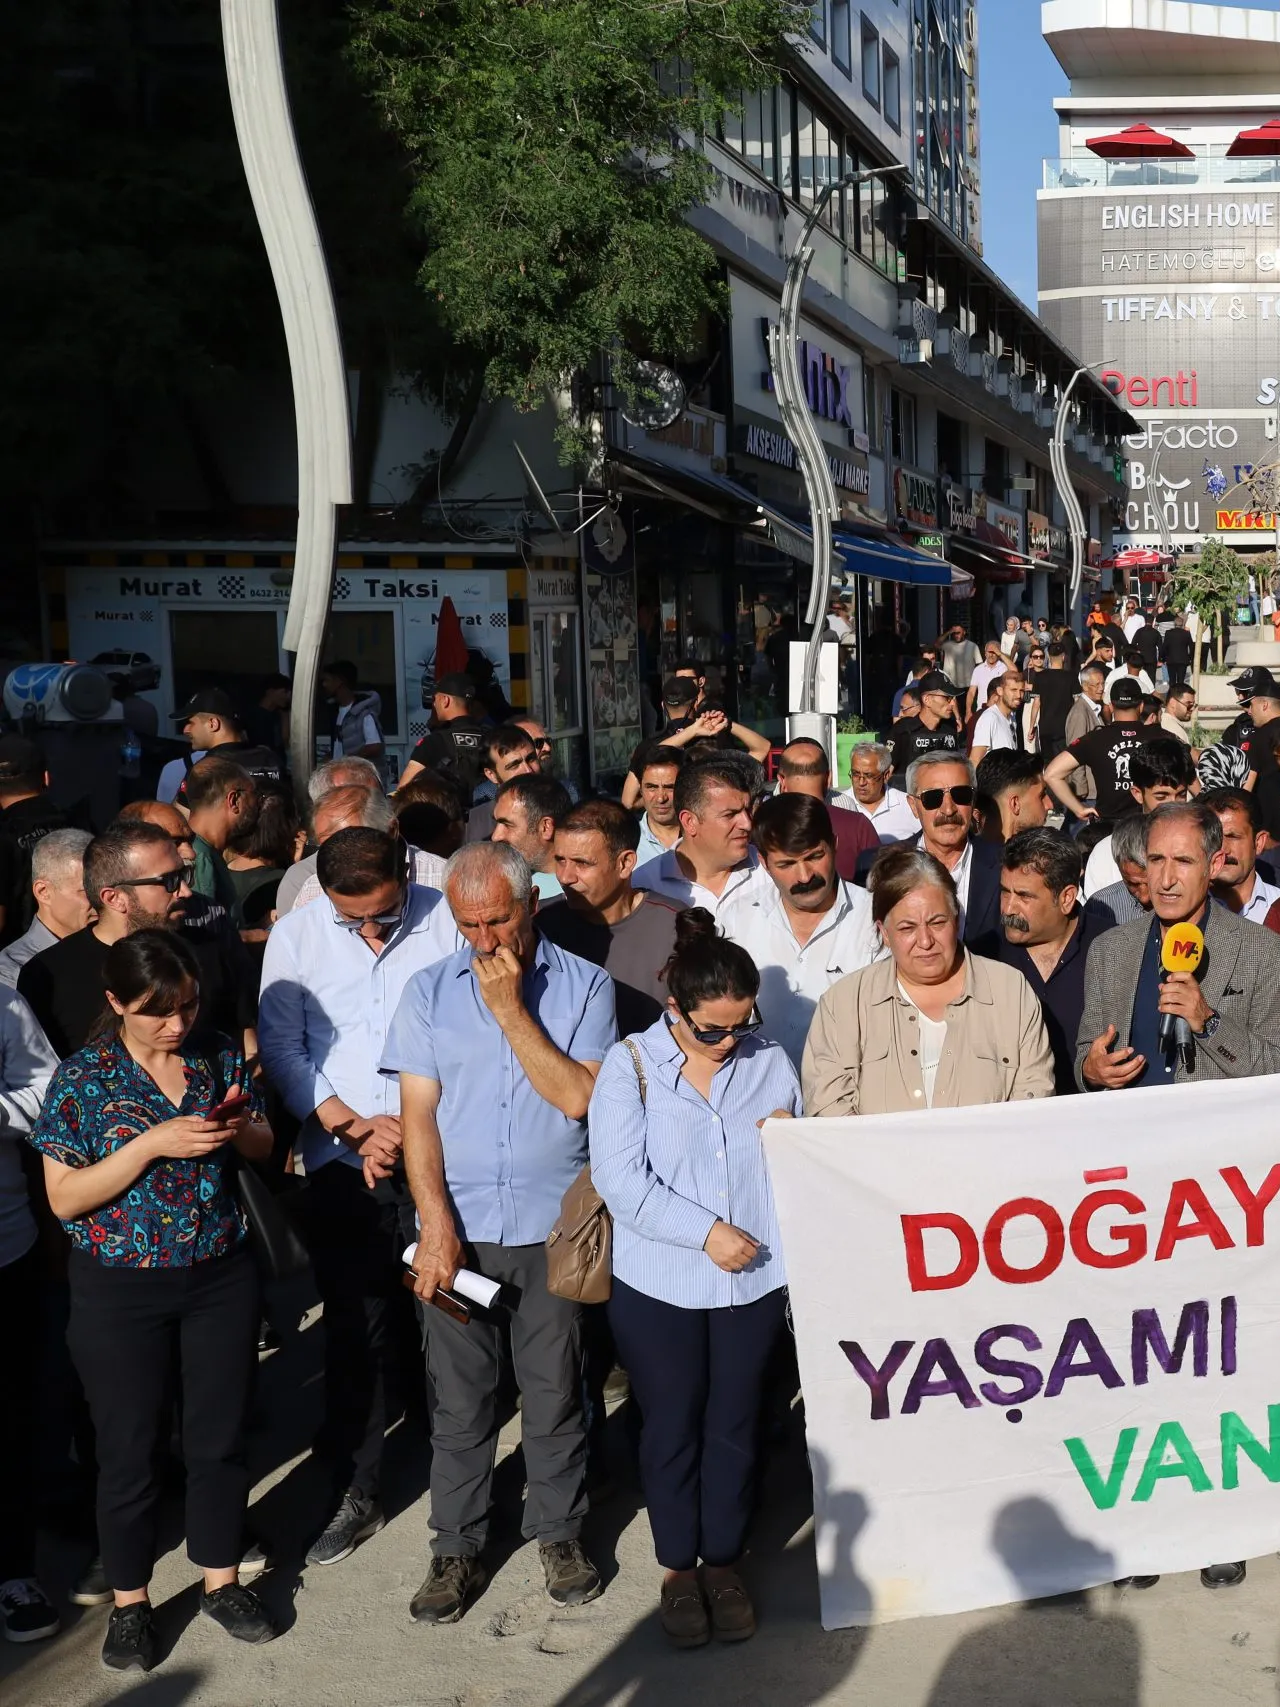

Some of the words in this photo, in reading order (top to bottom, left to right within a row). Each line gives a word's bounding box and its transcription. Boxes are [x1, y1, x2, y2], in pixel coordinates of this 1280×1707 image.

[1102, 204, 1199, 230] ENGLISH
[1207, 202, 1274, 228] HOME
[1102, 245, 1245, 272] HATEMOĞLU
[1102, 297, 1217, 322] TIFFANY
[1228, 296, 1247, 320] &
[1102, 370, 1197, 406] Penti
[746, 424, 793, 468] AKSESUAR
[1116, 420, 1239, 450] eFacto
[120, 577, 202, 597] Murat
[364, 578, 438, 598] Taksi
[95, 611, 134, 621] Murat
[1108, 741, 1133, 759] ÖZEL
[839, 1295, 1238, 1424] YAŞAMI
